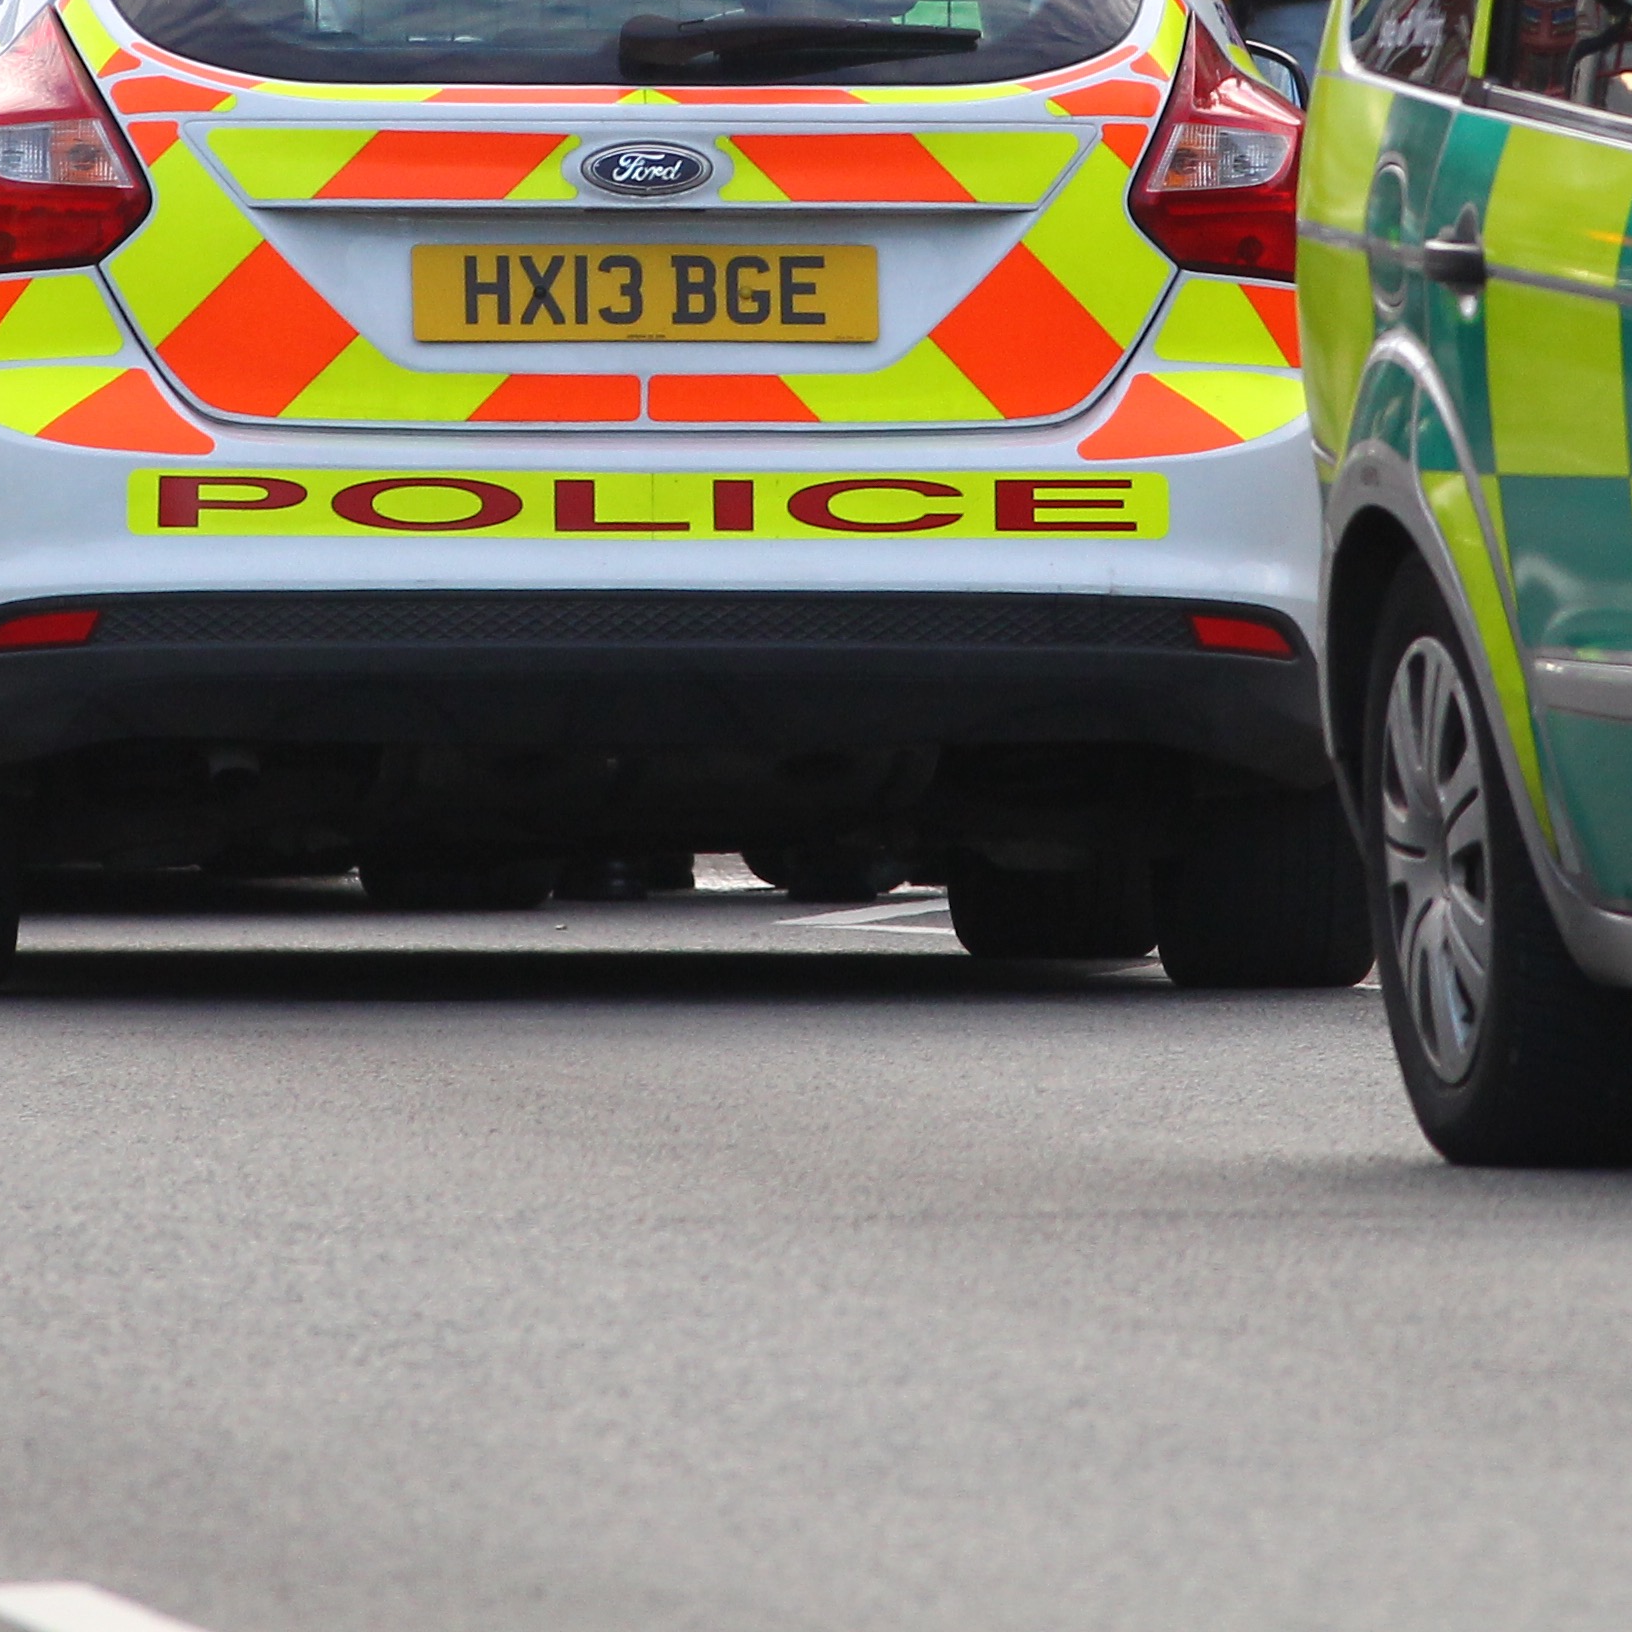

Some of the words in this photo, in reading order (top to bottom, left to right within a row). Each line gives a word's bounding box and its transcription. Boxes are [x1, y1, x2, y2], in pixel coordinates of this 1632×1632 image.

[612, 153, 684, 182] Ford
[464, 255, 644, 327] HX13
[671, 255, 826, 327] BGE
[156, 475, 1138, 533] POLICE
